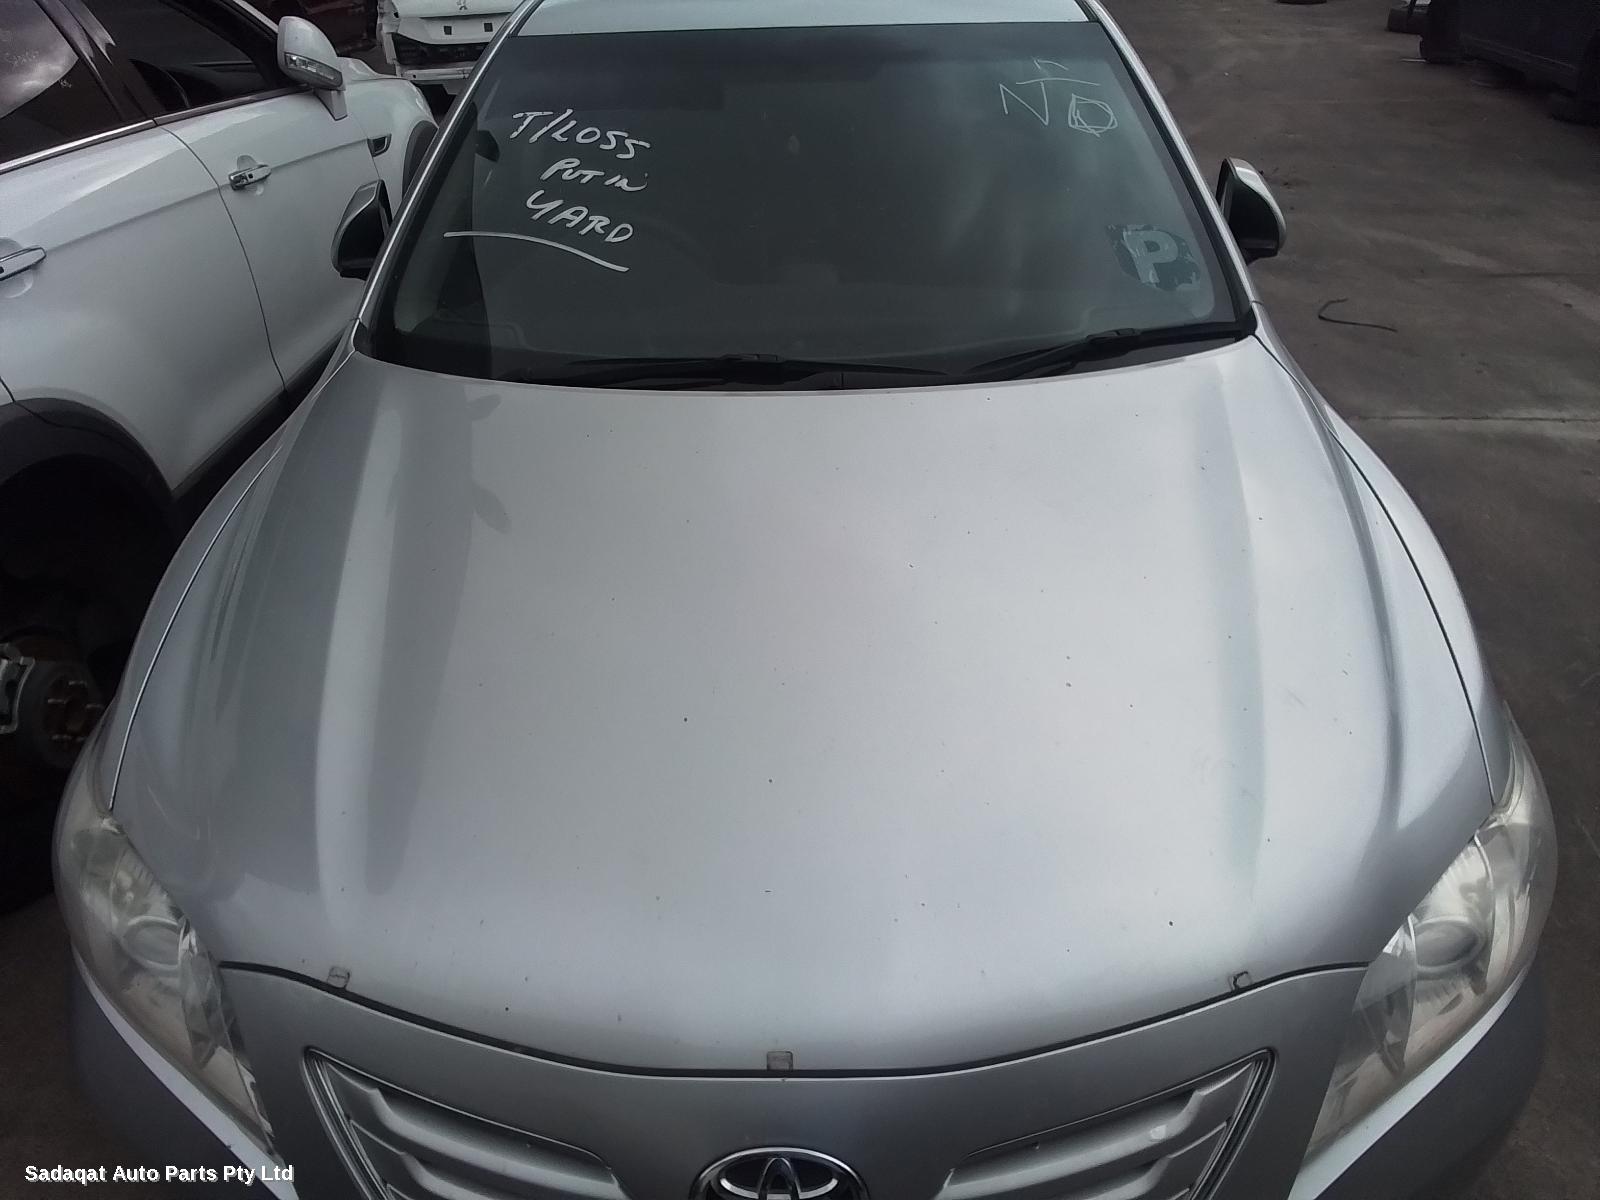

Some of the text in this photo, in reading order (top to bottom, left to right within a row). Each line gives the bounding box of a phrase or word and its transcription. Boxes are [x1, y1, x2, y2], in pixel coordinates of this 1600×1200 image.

[509, 108, 651, 159] T/LOSS
[540, 157, 605, 184] PUT
[526, 189, 634, 243] YARD
[1122, 229, 1180, 286] P
